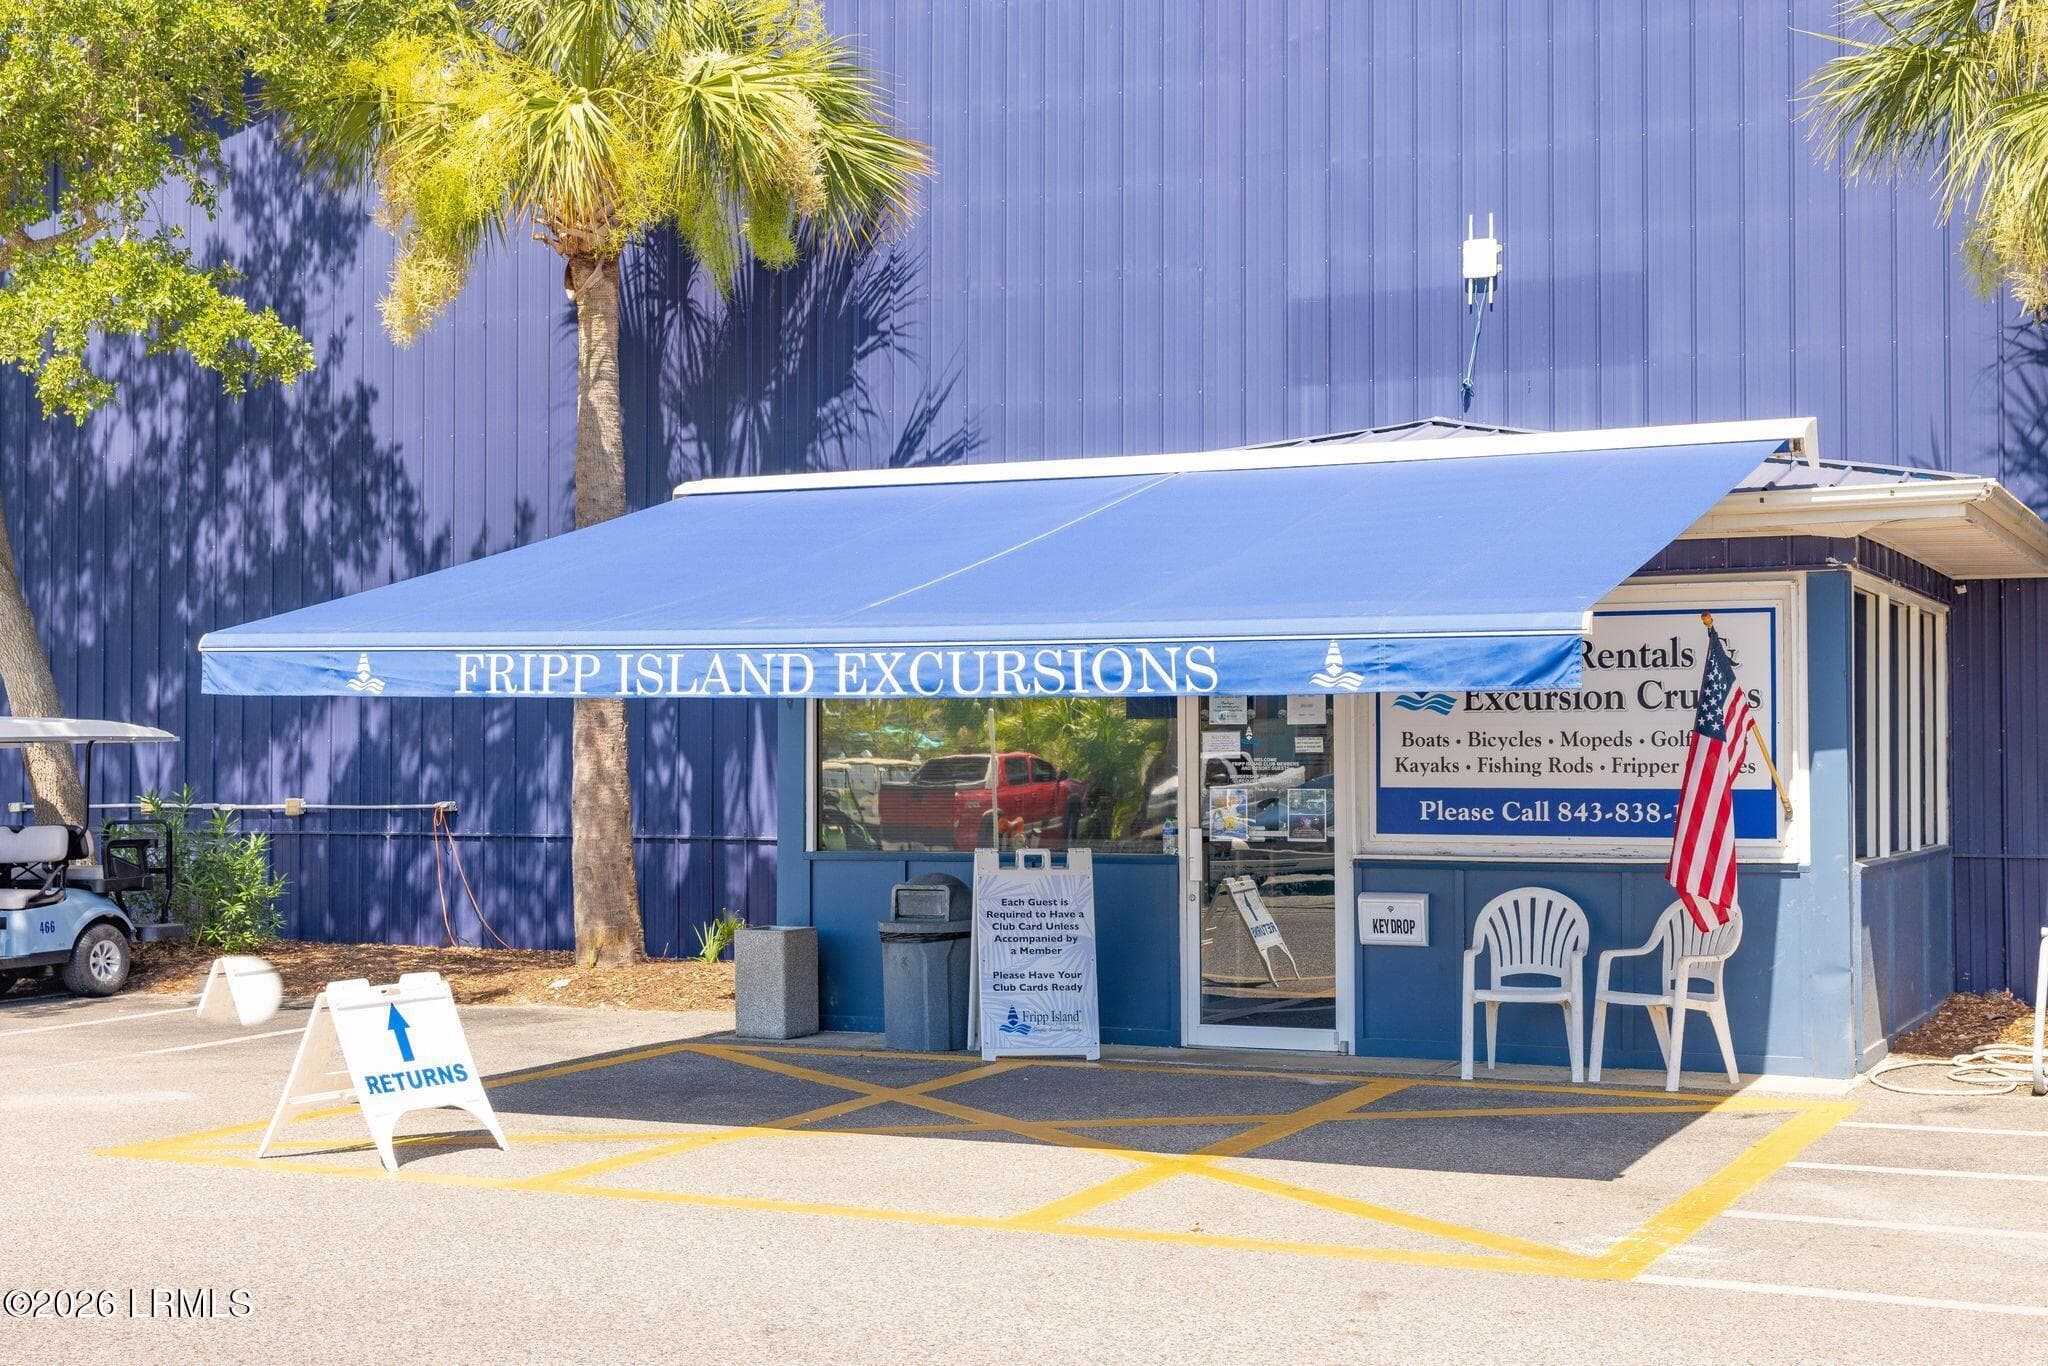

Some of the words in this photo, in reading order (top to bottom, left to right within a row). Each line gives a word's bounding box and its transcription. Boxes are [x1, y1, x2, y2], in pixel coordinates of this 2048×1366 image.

[455, 652, 600, 695] FRIPP
[615, 652, 814, 697] ISLAND
[833, 646, 1219, 697] EXCURSIONS
[1463, 688, 1626, 711] Excursion
[1401, 731, 1450, 748] Boats
[1468, 730, 1542, 751] Bicycles
[1560, 730, 1633, 751] Mopeds
[1651, 730, 1693, 747] Golf
[1395, 757, 1460, 777] Kayaks
[1478, 756, 1543, 777] Fishing
[1549, 756, 1594, 773] Rods
[1611, 756, 1680, 778] Fripper
[1419, 800, 1494, 822] Please
[1502, 800, 1551, 822] Call
[1001, 898, 1025, 906] Each
[1027, 898, 1058, 906] Guest
[1060, 898, 1069, 906] is
[986, 910, 1032, 920] Required
[1035, 911, 1046, 919] to
[1050, 910, 1076, 919] Have
[39, 920, 56, 934] 466
[992, 922, 1016, 931] Club
[1018, 922, 1043, 931] Card
[1046, 922, 1080, 931] Unless
[1372, 918, 1389, 934] KEY
[1391, 918, 1416, 935] DROP
[994, 934, 1063, 945] Accompanied
[1066, 934, 1078, 945] by
[1020, 946, 1063, 955] Member
[993, 971, 1026, 980] Please
[1028, 971, 1055, 980] Have
[1057, 971, 1082, 980] Your
[992, 983, 1017, 992] Club
[1019, 983, 1049, 992] Cards
[1051, 983, 1083, 993] Ready
[1022, 1010, 1049, 1025] Fripp
[1051, 1010, 1080, 1022] Island
[364, 1063, 469, 1095] RETURNS
